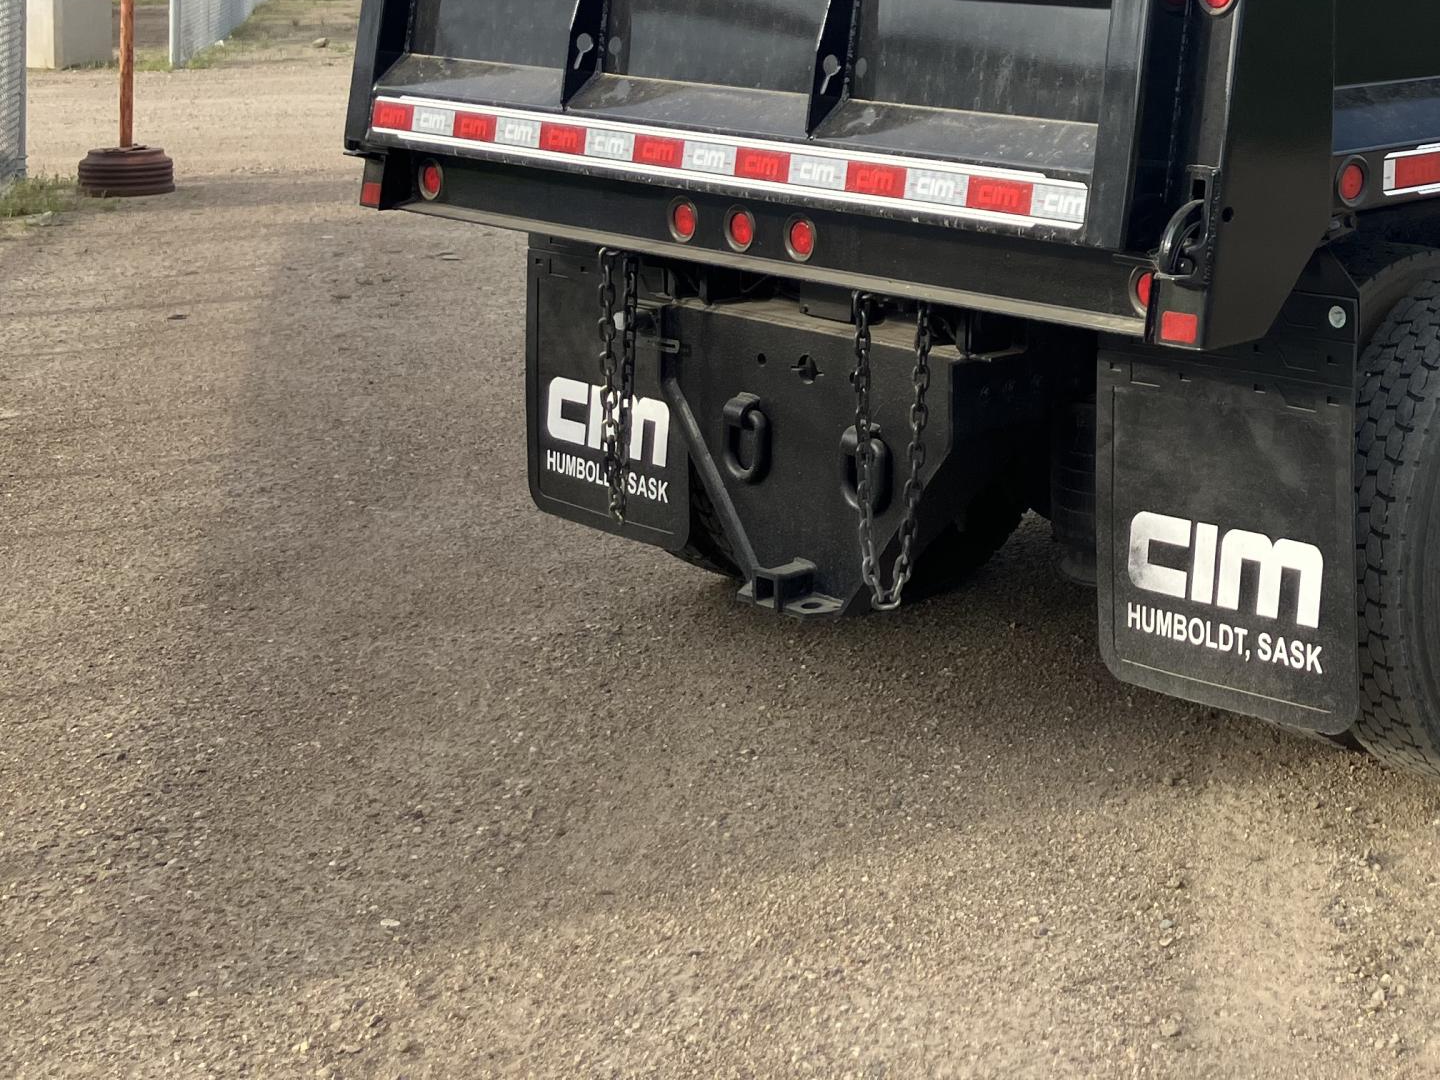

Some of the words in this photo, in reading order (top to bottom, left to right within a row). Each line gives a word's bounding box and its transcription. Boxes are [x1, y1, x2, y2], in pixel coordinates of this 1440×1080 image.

[546, 449, 616, 489] HUMBOL
[627, 471, 669, 504] SASK
[1127, 601, 1251, 663] HUMBOLDT,
[1257, 631, 1324, 675] SASK
